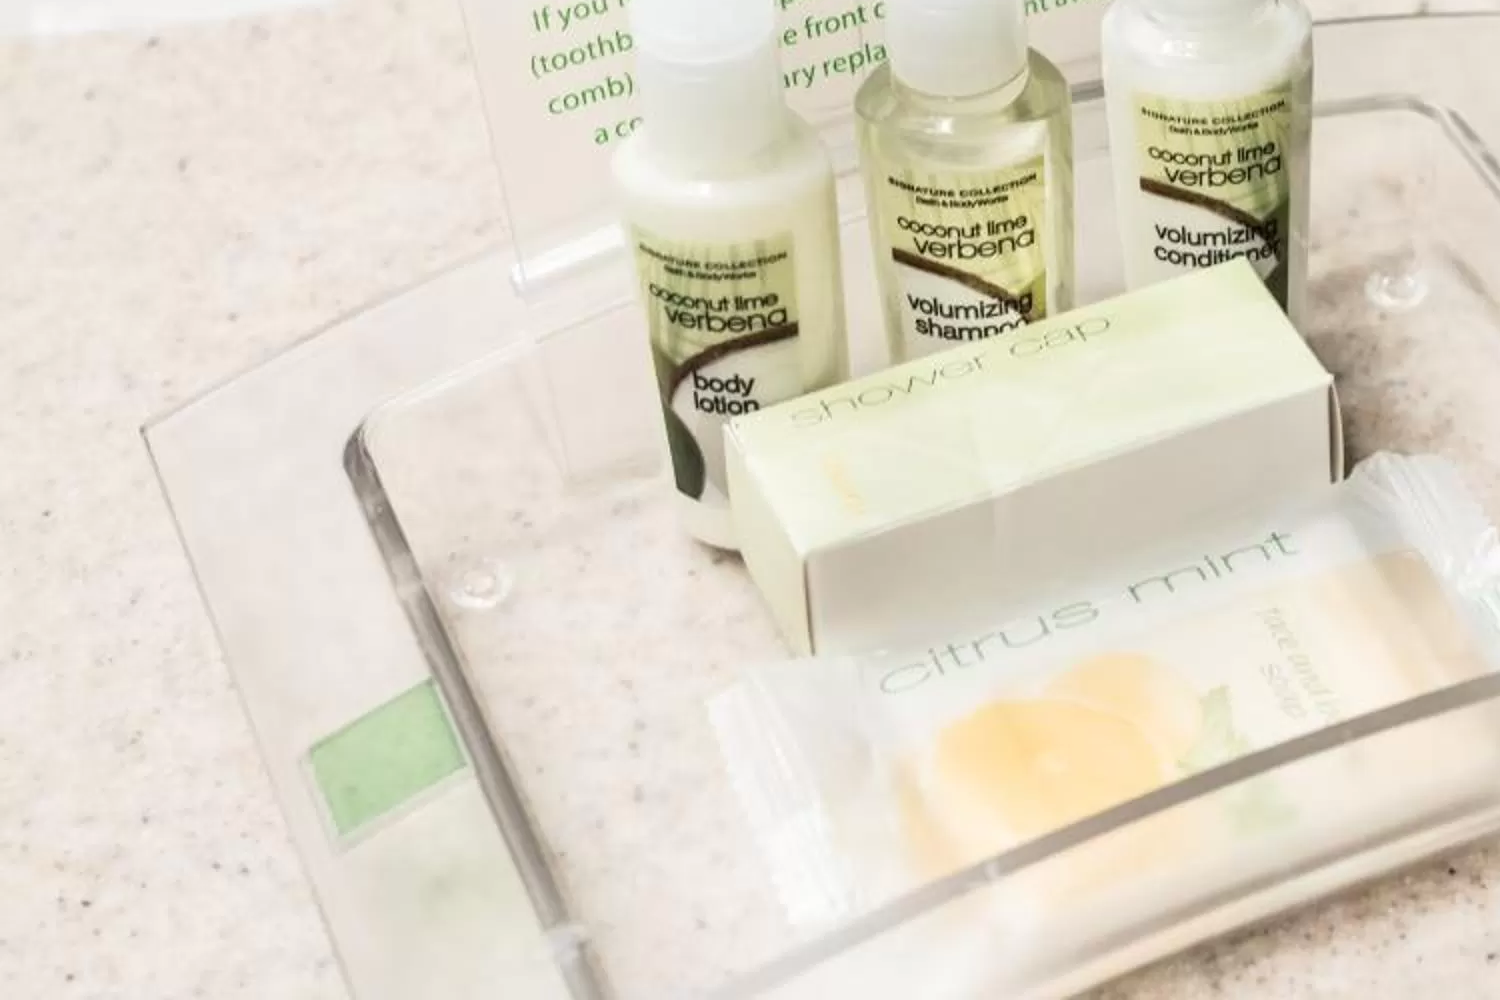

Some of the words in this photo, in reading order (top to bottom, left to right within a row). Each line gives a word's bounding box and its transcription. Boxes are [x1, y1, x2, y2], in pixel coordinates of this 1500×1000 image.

[532, 5, 551, 33] If
[530, 28, 634, 80] (toothb
[547, 70, 634, 116] comb)
[804, 4, 869, 40] front
[593, 126, 610, 146] a
[822, 41, 889, 80] repla
[1141, 105, 1209, 126] SIGNATURE
[1211, 98, 1287, 126] COLLECTION
[1147, 145, 1234, 167] coconut
[1236, 141, 1276, 163] lime
[888, 175, 957, 197] SIGNATURE
[958, 172, 1038, 198] COLLECTION
[1164, 154, 1283, 188] verbena
[896, 214, 982, 239] coconut
[986, 214, 1029, 238] lime
[1154, 217, 1280, 247] volumizing
[912, 228, 1036, 260] verbena
[1152, 236, 1281, 269] conditiner
[704, 251, 789, 271] COLLECTION
[648, 282, 730, 312] coconut
[734, 292, 780, 312] lime
[906, 292, 1034, 320] volumizing
[663, 306, 789, 333] verbena
[691, 364, 757, 398] body
[791, 352, 990, 430] shower
[1010, 313, 1114, 358] cap
[692, 390, 761, 416] lotion
[879, 599, 1101, 695] citrus
[1127, 530, 1300, 604] mint
